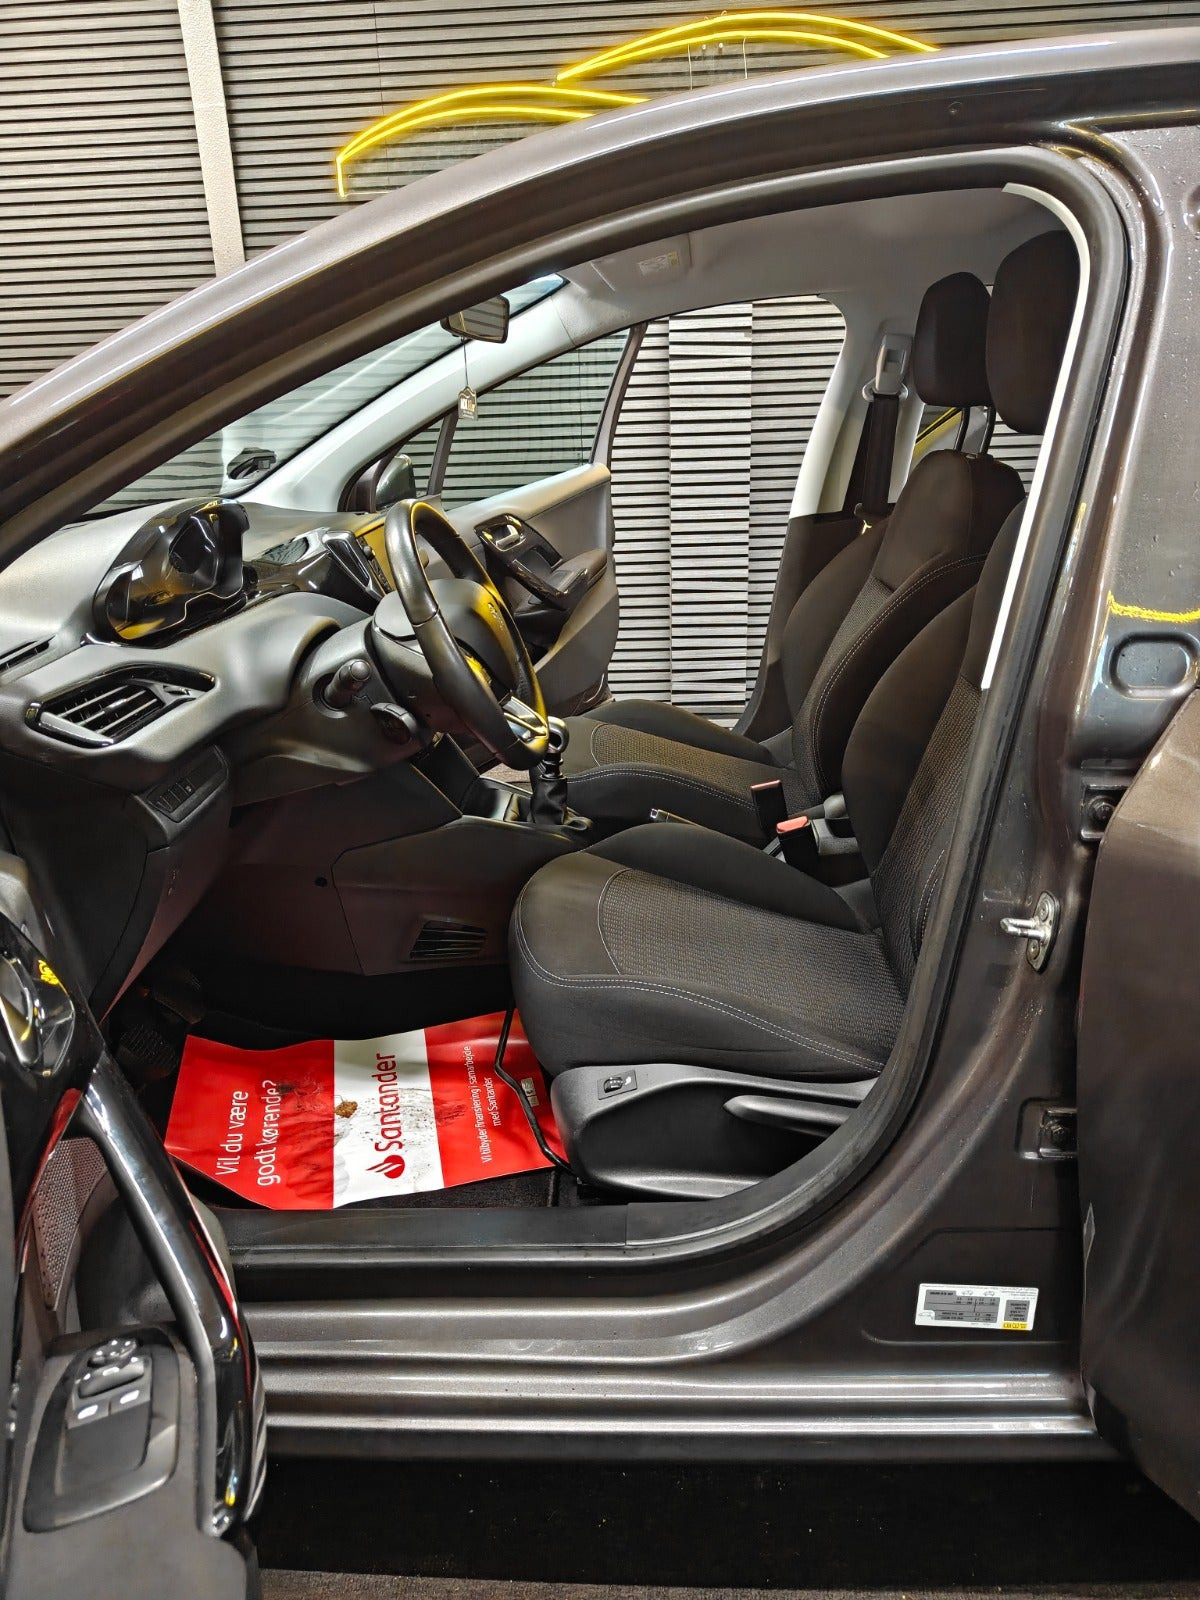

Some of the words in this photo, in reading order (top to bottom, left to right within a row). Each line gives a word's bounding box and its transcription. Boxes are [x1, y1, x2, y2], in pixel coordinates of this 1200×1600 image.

[463, 1045, 478, 1085] samarbejde
[229, 1090, 249, 1130] være
[255, 1079, 282, 1147] kørende?
[371, 1052, 404, 1152] Santander
[470, 1088, 485, 1128] finansiering
[483, 1077, 499, 1112] Santander
[488, 1111, 502, 1127] med
[220, 1133, 243, 1153] du
[477, 1128, 492, 1155] tilbyder
[215, 1155, 241, 1175] Vil
[253, 1147, 282, 1187] godt
